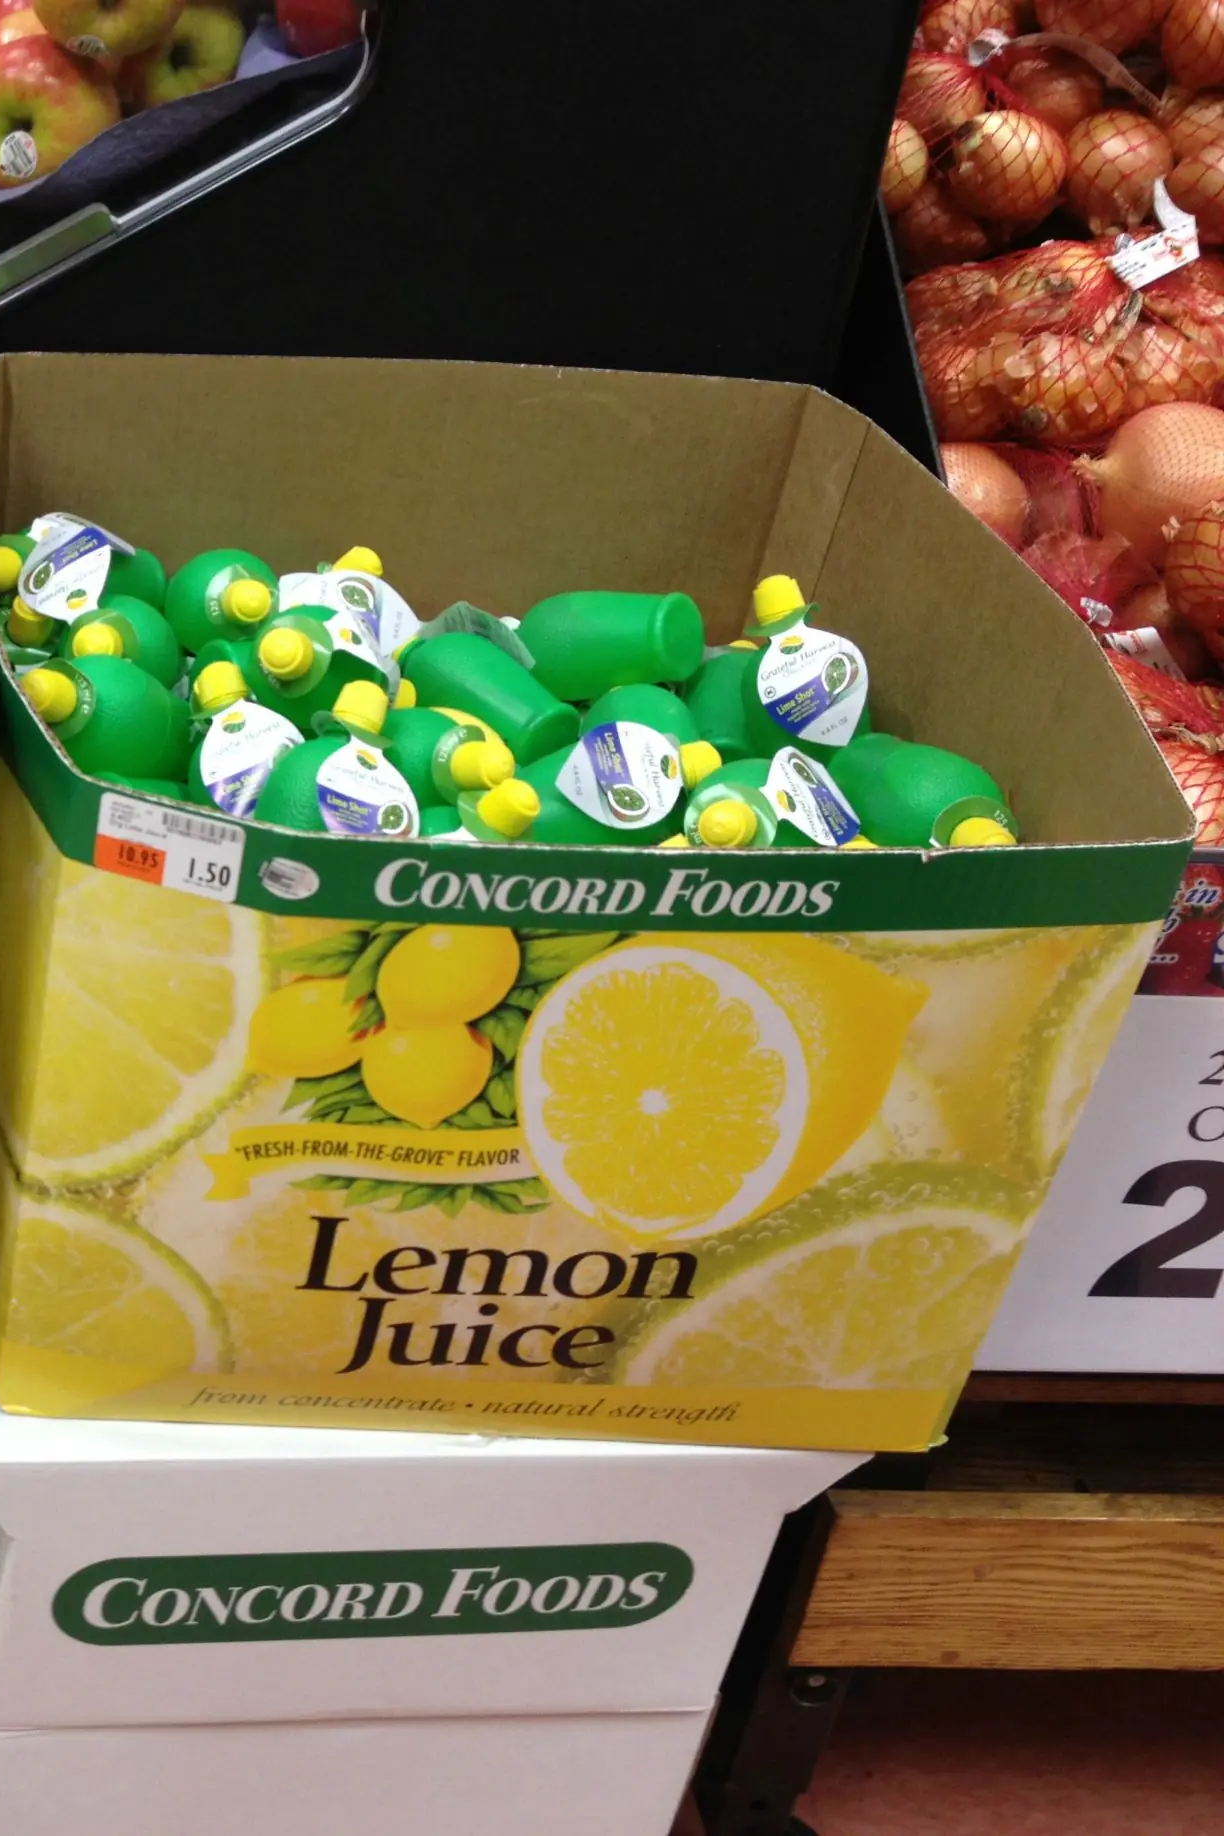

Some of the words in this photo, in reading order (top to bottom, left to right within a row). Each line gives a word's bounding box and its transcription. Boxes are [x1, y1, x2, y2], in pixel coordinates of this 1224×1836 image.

[800, 640, 837, 661] Harvest
[776, 698, 796, 716] Lime
[794, 687, 815, 703] Shot
[604, 732, 617, 753] Lime
[326, 794, 348, 809] Lime
[348, 800, 370, 815] Shot
[117, 844, 160, 869] 10.95
[188, 857, 232, 887] 1.50
[374, 857, 647, 915] CONCORD
[649, 867, 841, 917] FOODS
[456, 1148, 521, 1167] FLAVOR
[294, 1215, 699, 1300] Lemon
[334, 1296, 617, 1375] Juice
[189, 1384, 269, 1408] from
[277, 1390, 457, 1414] concentrate
[482, 1396, 601, 1418] natural
[608, 1399, 743, 1426] strength
[82, 1576, 424, 1629] CONCORD
[431, 1565, 668, 1621] FOODS
